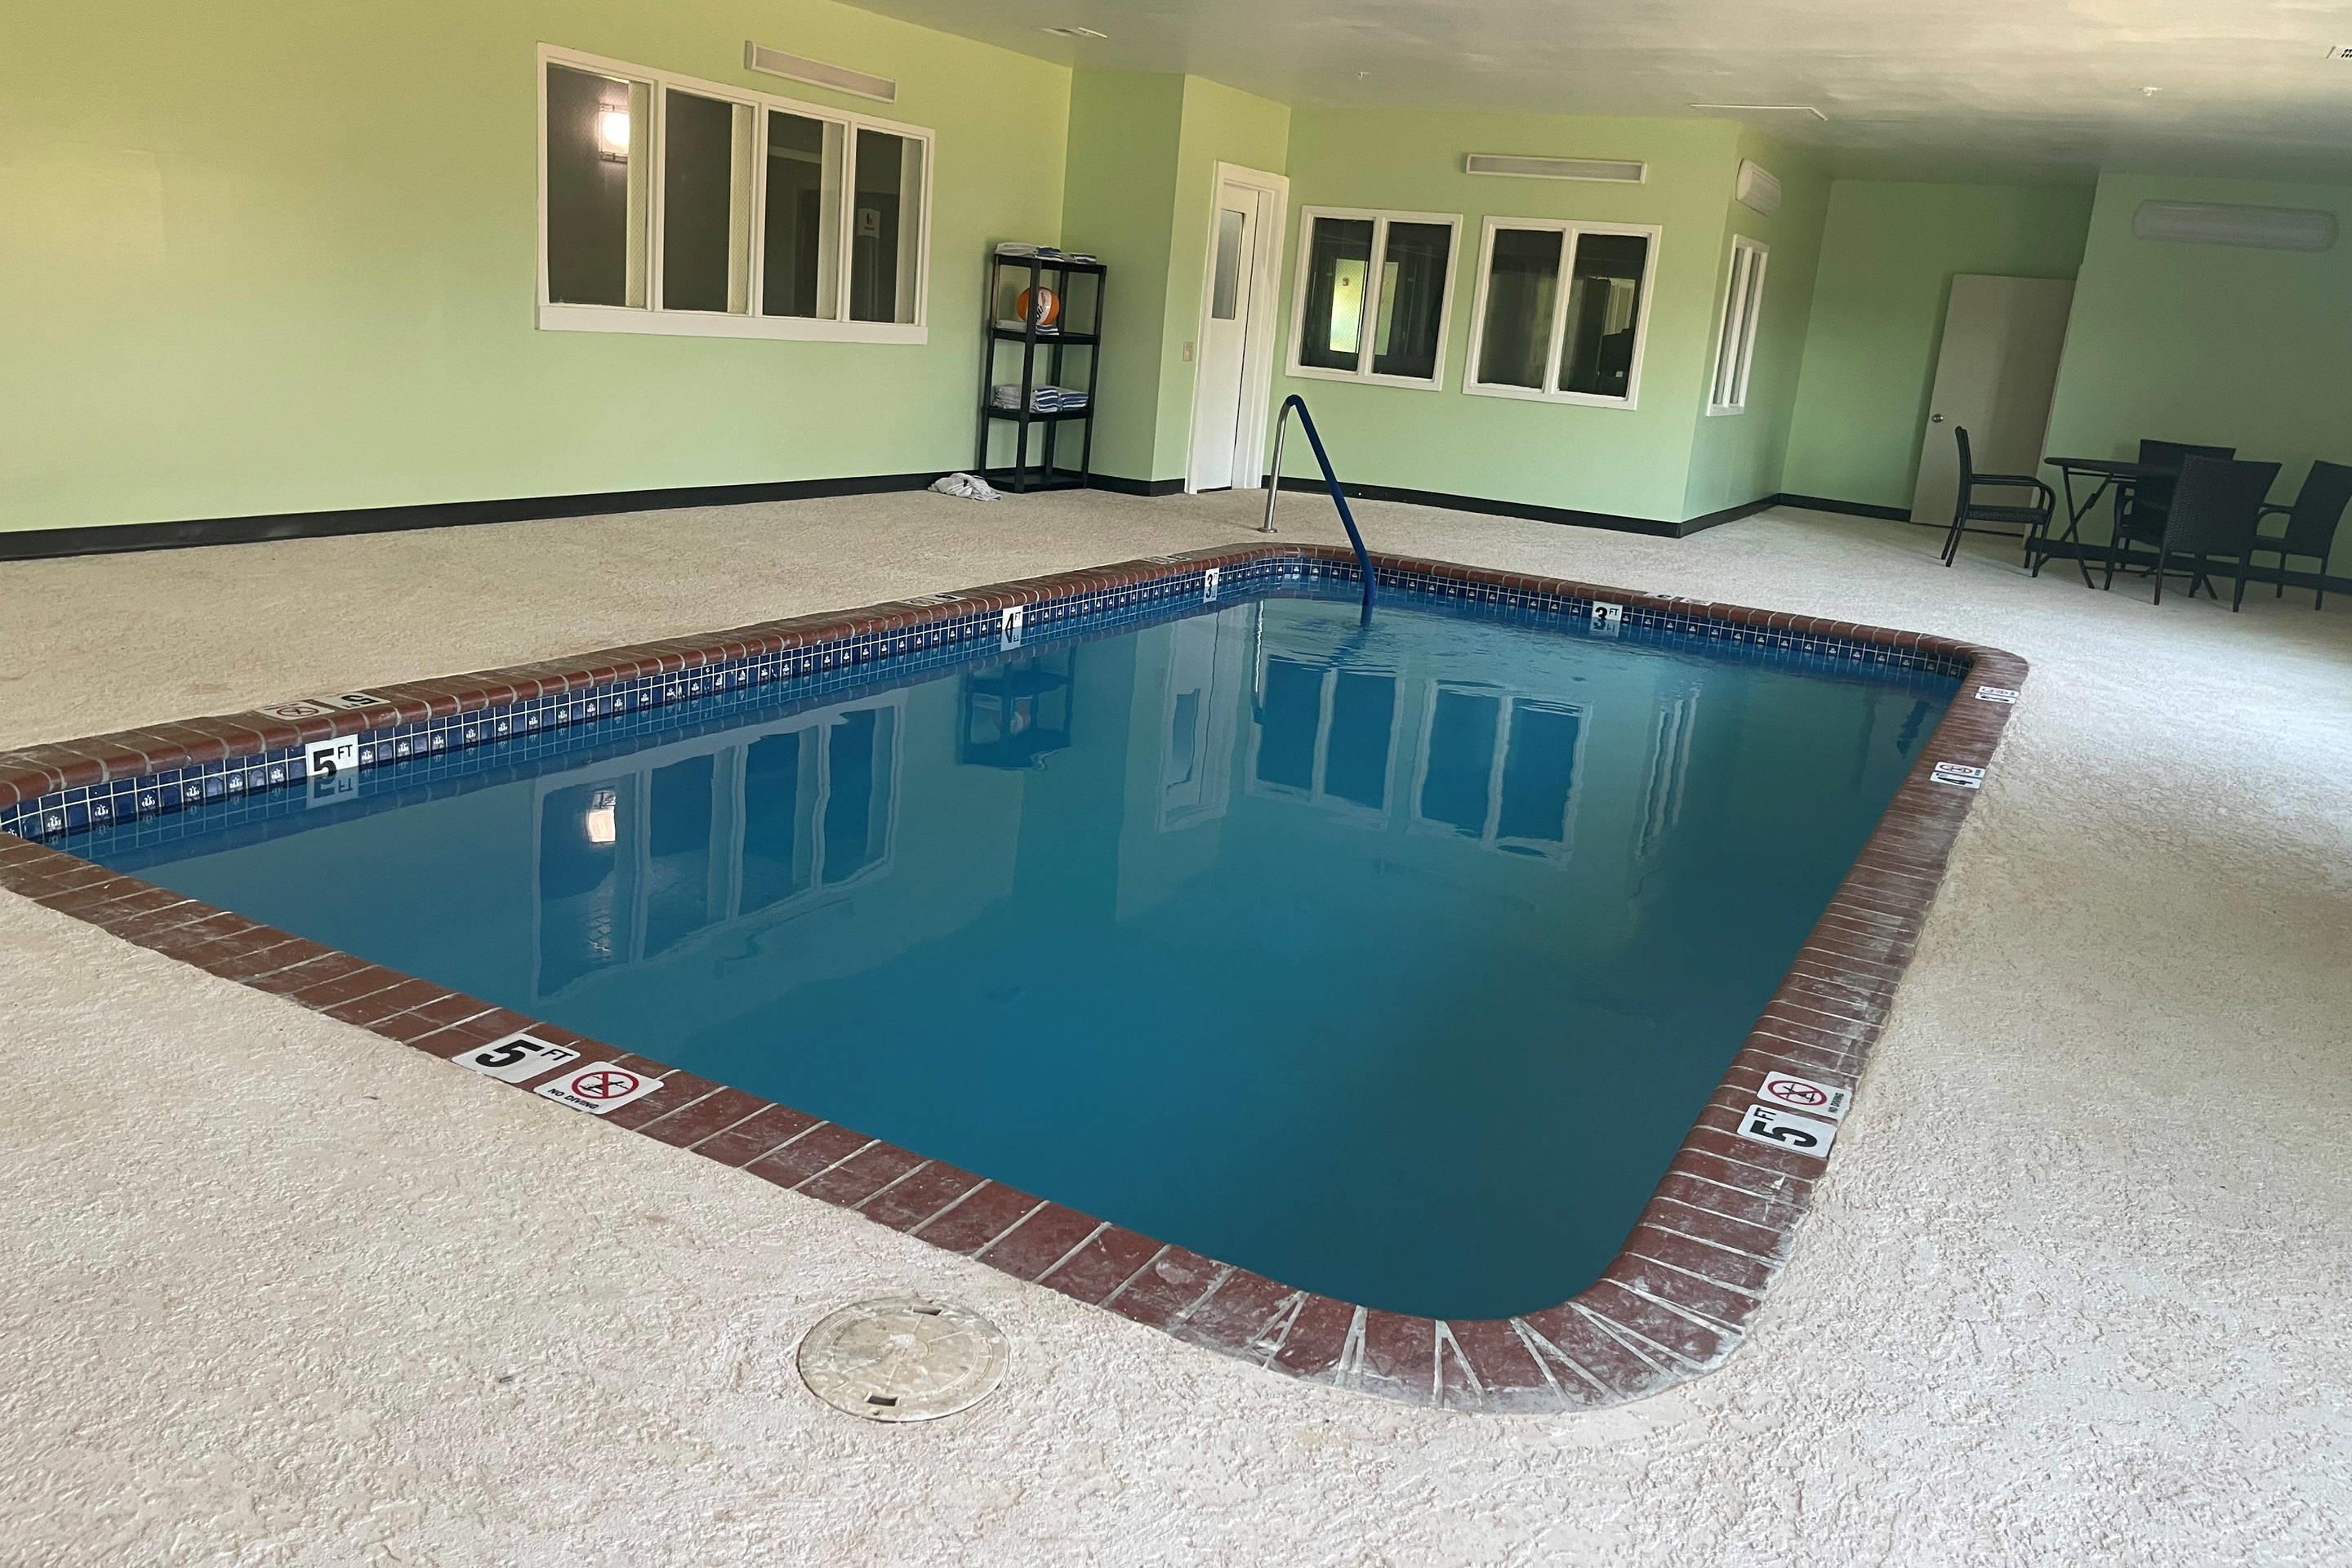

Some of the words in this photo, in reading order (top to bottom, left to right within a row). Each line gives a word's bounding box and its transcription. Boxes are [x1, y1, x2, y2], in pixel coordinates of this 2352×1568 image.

[1207, 574, 1213, 587] 3
[1005, 612, 1013, 630] 4
[1595, 607, 1608, 621] 3
[341, 695, 381, 705] 5
[314, 748, 336, 777] 5
[338, 745, 353, 760] FT
[475, 1039, 545, 1067] 5
[541, 1049, 574, 1061] FT
[564, 1095, 599, 1109] DIVING
[1753, 1107, 1776, 1121] FT
[1750, 1120, 1817, 1147] 5
